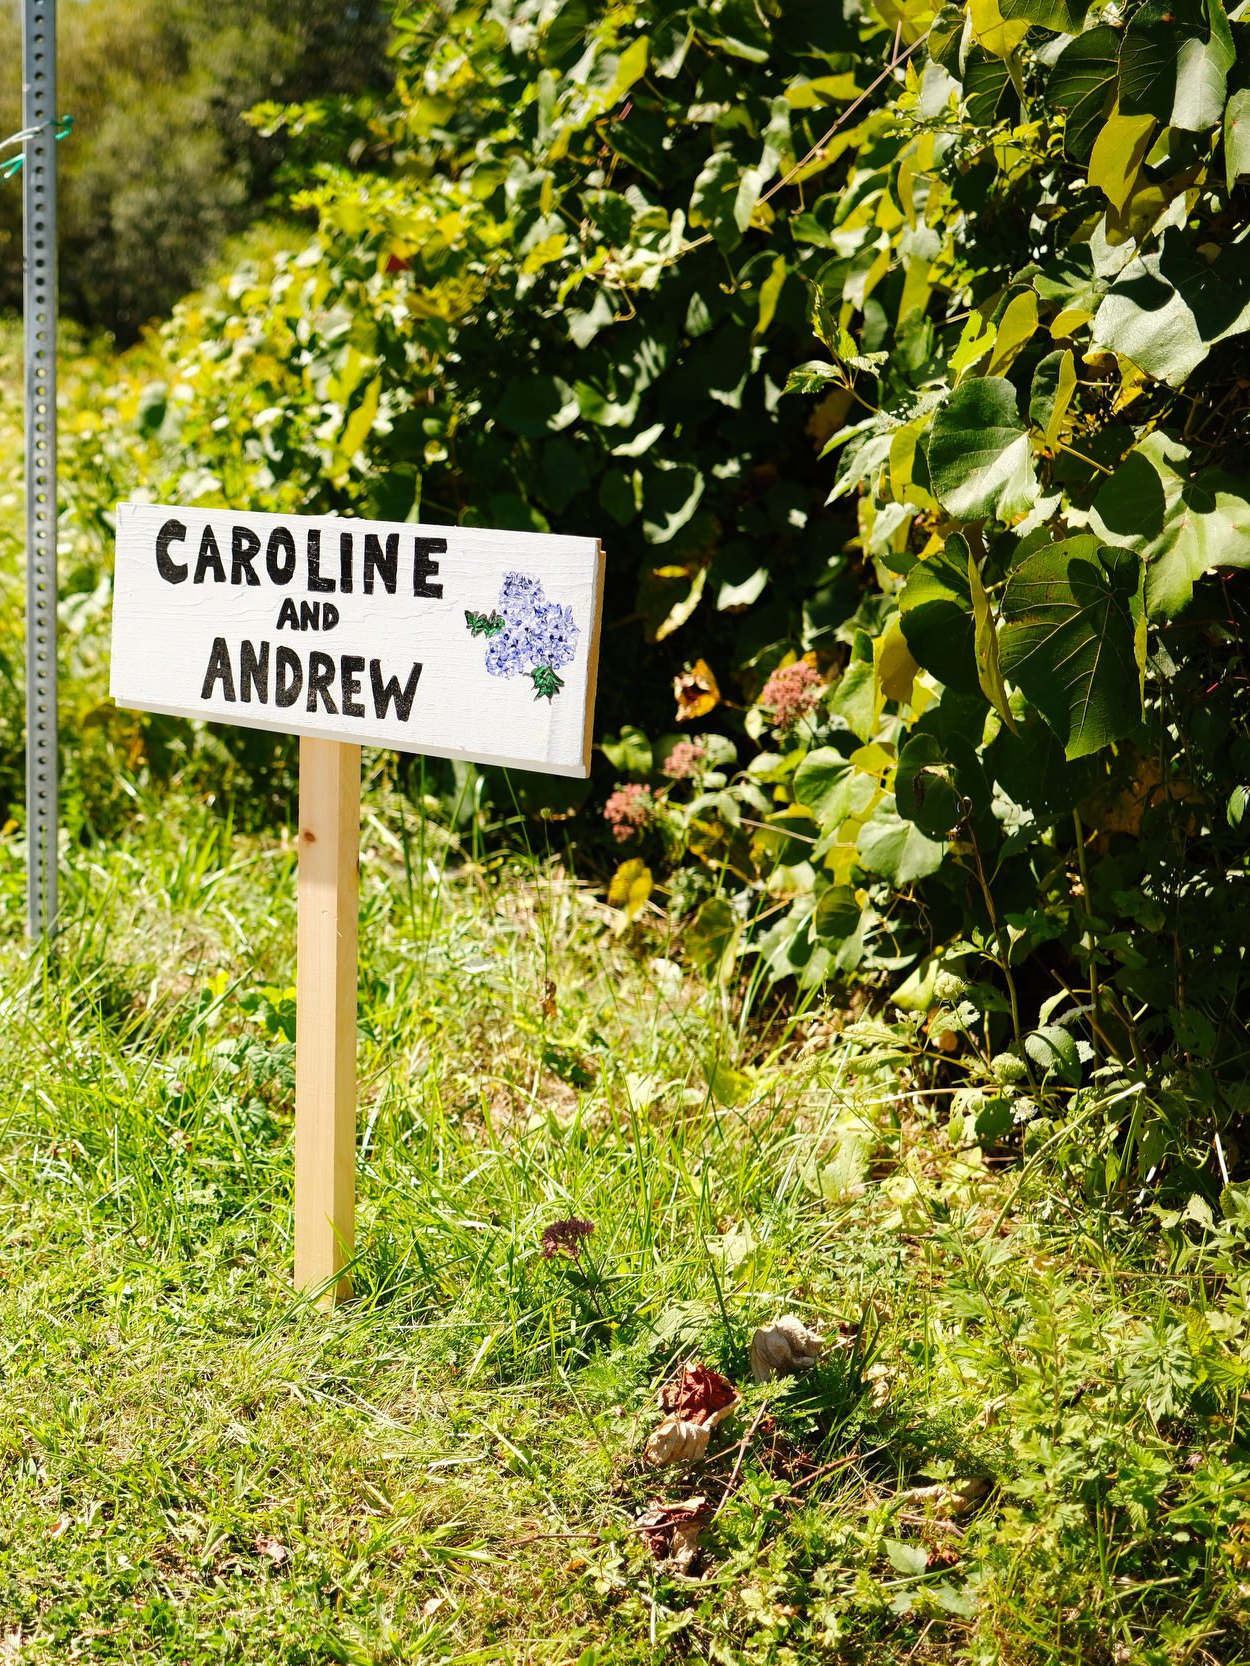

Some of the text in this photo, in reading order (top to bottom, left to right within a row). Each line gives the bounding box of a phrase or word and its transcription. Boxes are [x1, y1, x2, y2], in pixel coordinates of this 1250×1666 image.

[156, 518, 448, 600] CAROLINE
[276, 597, 340, 632] AND
[200, 636, 424, 723] ANDREW
